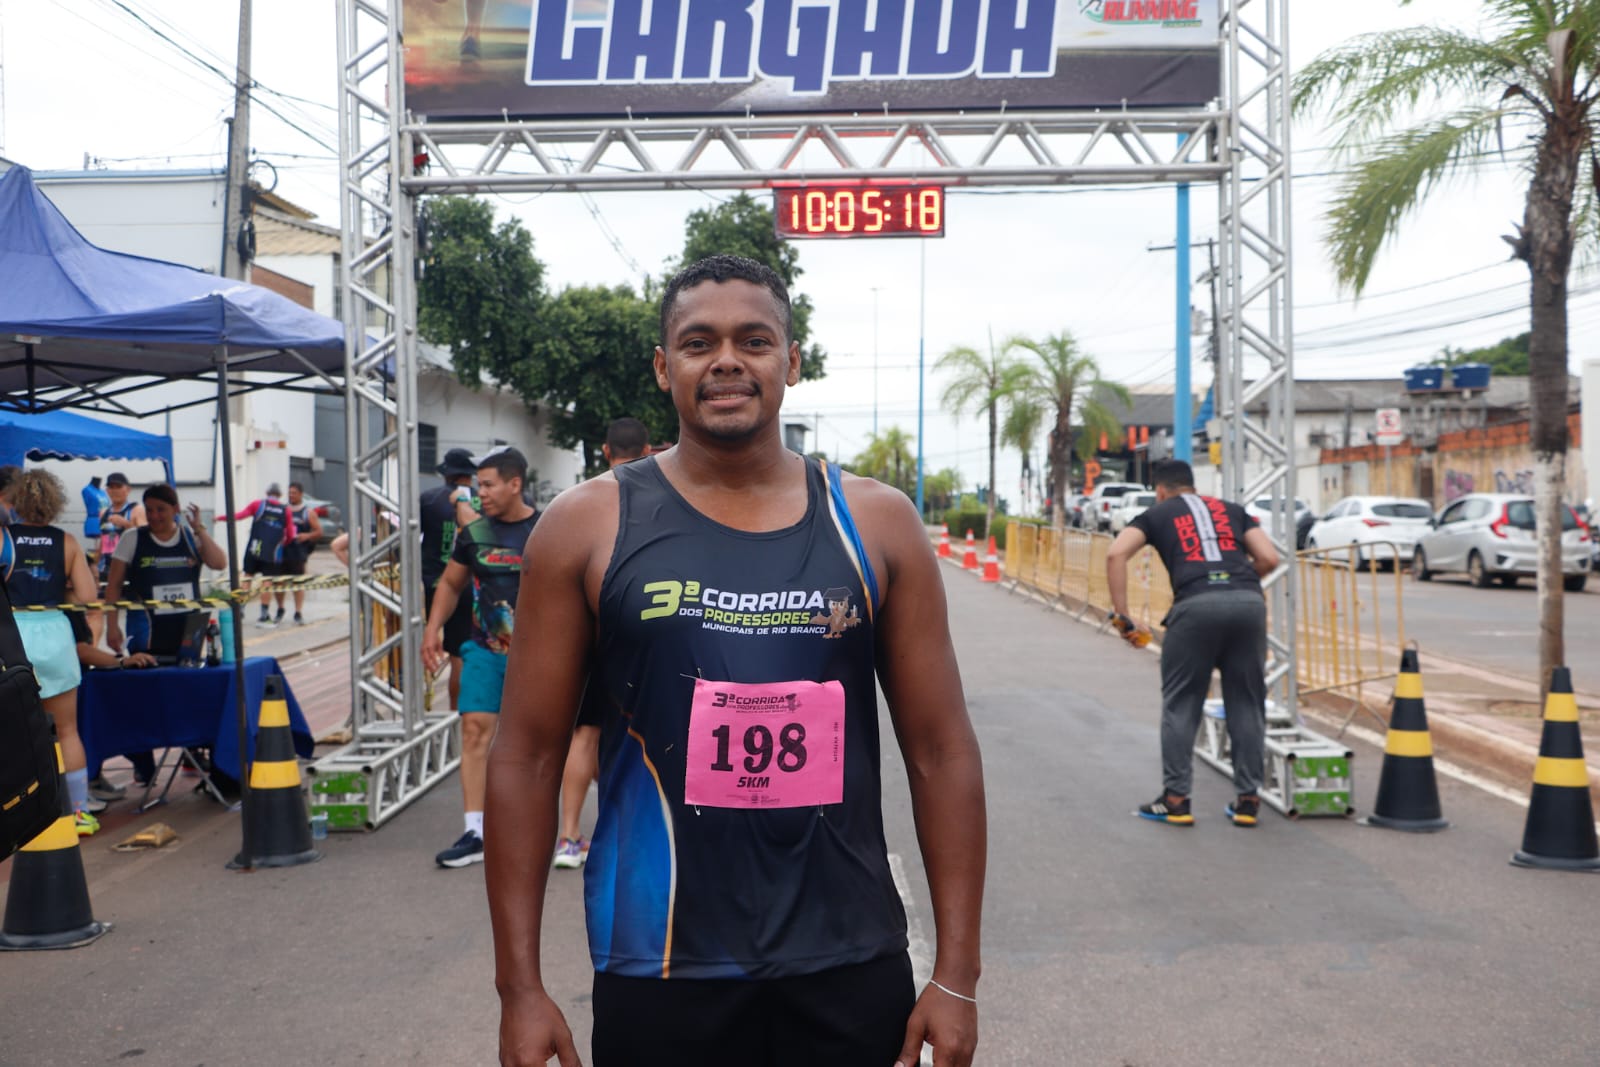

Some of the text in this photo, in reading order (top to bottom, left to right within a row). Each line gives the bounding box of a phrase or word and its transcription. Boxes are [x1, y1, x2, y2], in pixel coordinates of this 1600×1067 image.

[1103, 0, 1198, 21] RUNNING
[791, 190, 941, 232] 10:05:18
[1200, 495, 1238, 551] RUNN
[16, 536, 53, 545] ATLETA
[1173, 513, 1206, 562] ACRE
[641, 580, 825, 620] 3ª CORRIDA
[679, 607, 811, 627] DOS PROFESSORES
[702, 622, 826, 635] MUNICIPAIS DE RIO BRANCO
[735, 696, 785, 705] CORRIDA
[710, 722, 808, 774] 198
[736, 776, 770, 789] 5KM
